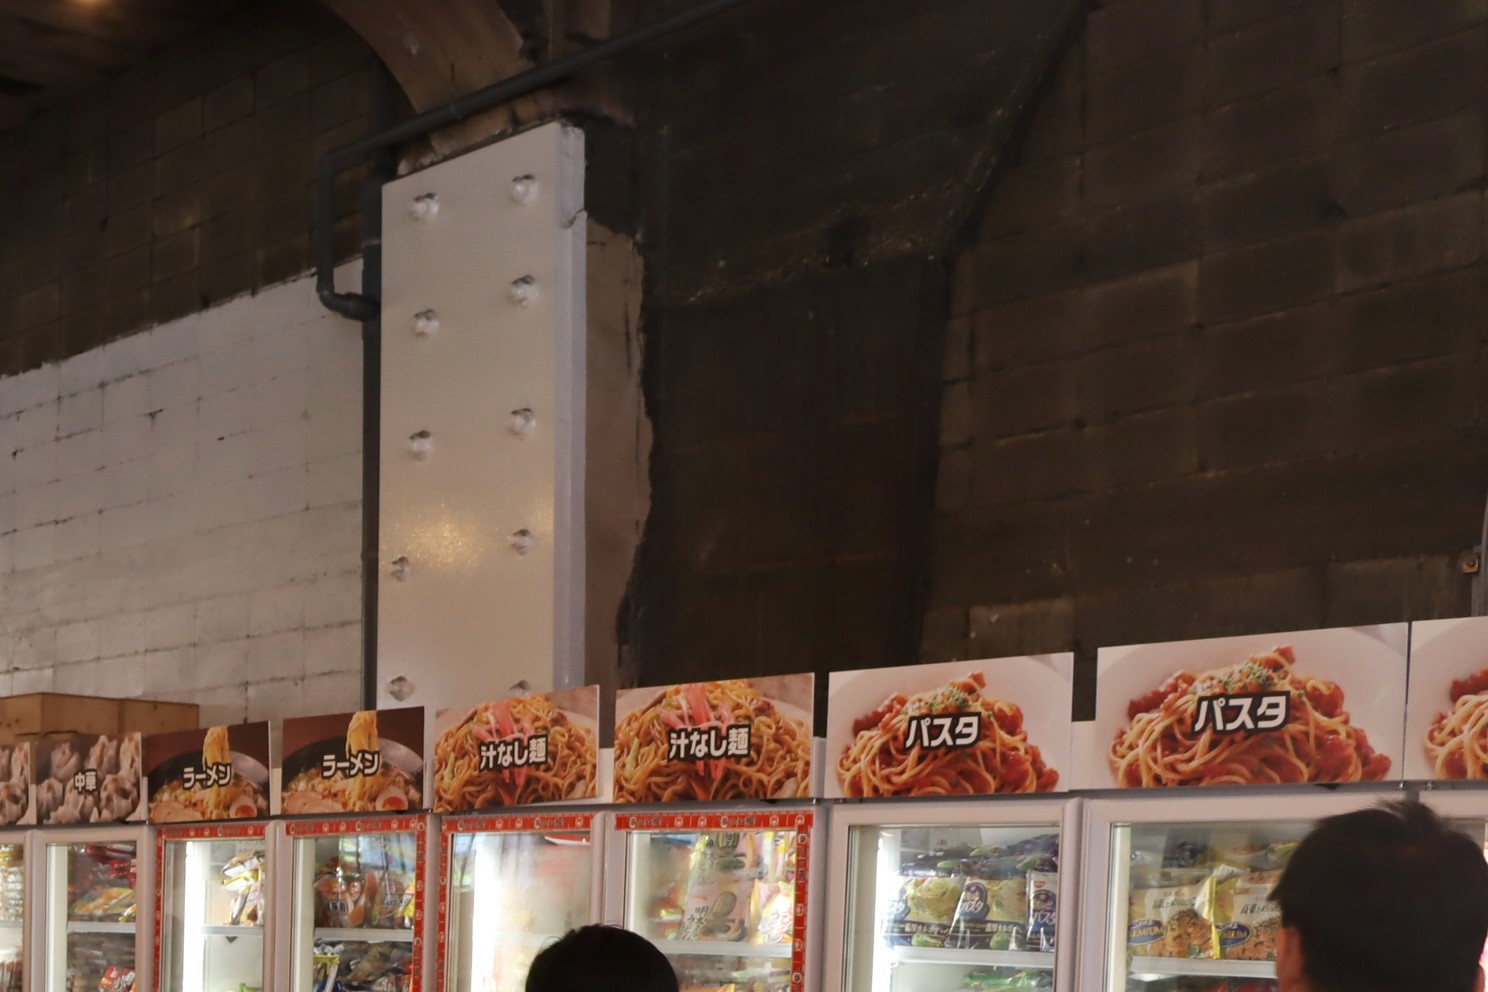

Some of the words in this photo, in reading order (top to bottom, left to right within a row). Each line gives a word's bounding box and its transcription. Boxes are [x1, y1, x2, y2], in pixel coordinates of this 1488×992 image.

[1193, 691, 1289, 733] パスタ
[668, 724, 751, 761] 汁なし麺
[906, 713, 980, 750] パスタ
[322, 751, 380, 778] ラーメン
[480, 734, 548, 770] 汁なし麺
[73, 771, 98, 792] 中華
[183, 762, 232, 789] ラーメン
